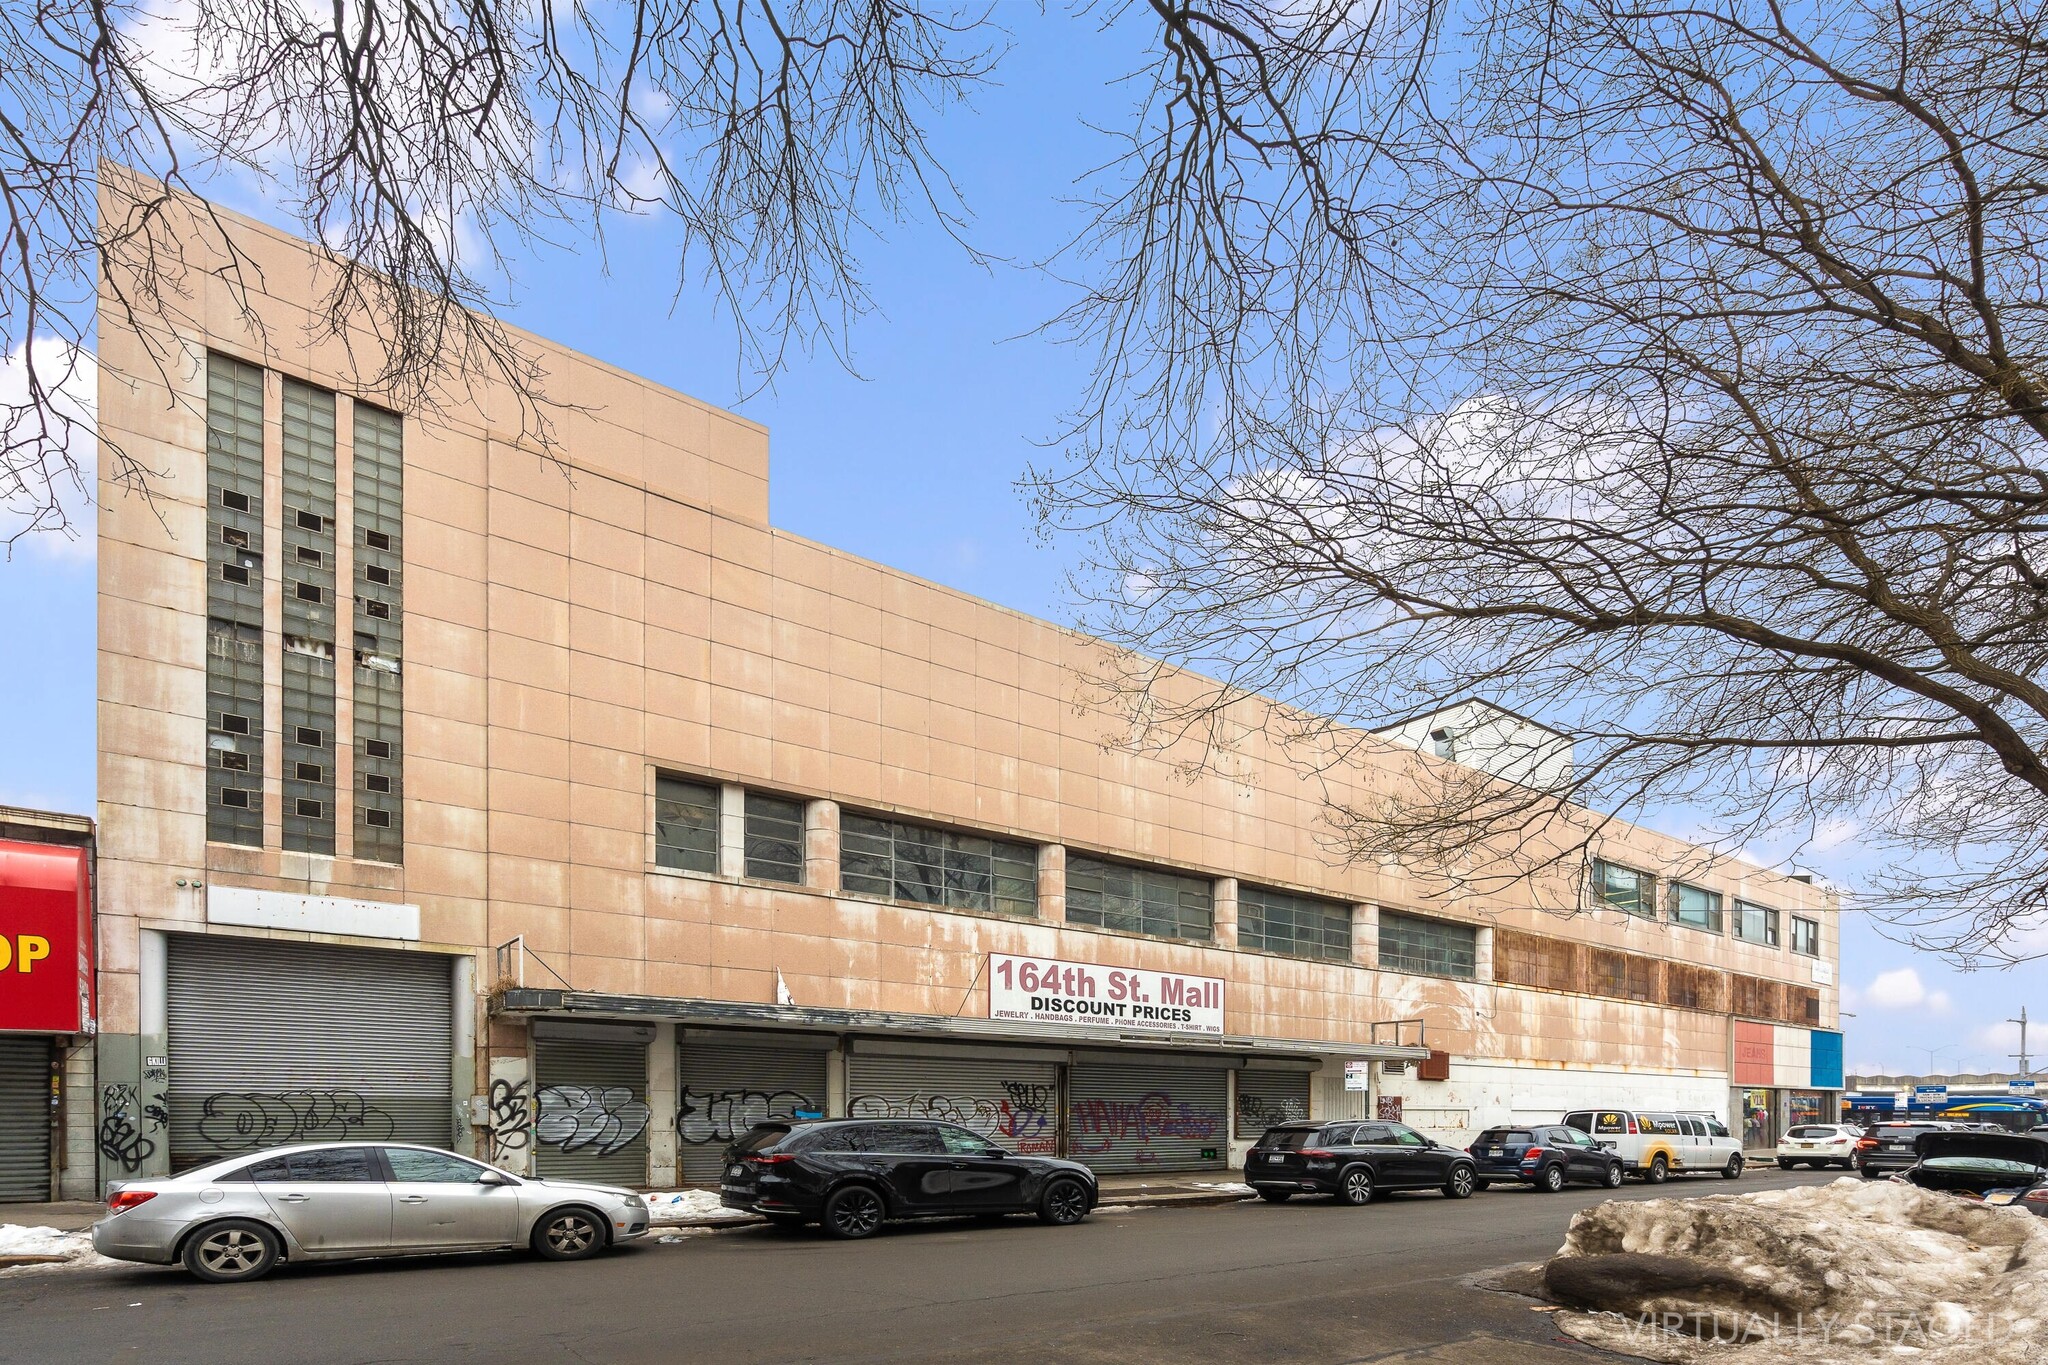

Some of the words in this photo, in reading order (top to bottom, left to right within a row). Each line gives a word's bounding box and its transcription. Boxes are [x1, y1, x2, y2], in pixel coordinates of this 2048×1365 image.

[997, 959, 1096, 998] 164th
[1107, 971, 1149, 1003] St.
[1161, 977, 1219, 1009] Mall
[1031, 996, 1127, 1017] DISCOUNT
[1132, 1005, 1191, 1022] PRICES
[994, 1010, 1029, 1019] JEWELRY
[1034, 1012, 1073, 1022] HANDBAGS
[1078, 1016, 1110, 1025] PERFUME
[1136, 1020, 1177, 1030] ACCESSORIES
[1180, 1023, 1202, 1031] T-SHIRT
[1205, 1025, 1221, 1033] WIGS
[1742, 1046, 1766, 1059] JEANS
[1653, 1120, 1676, 1130] Mpower
